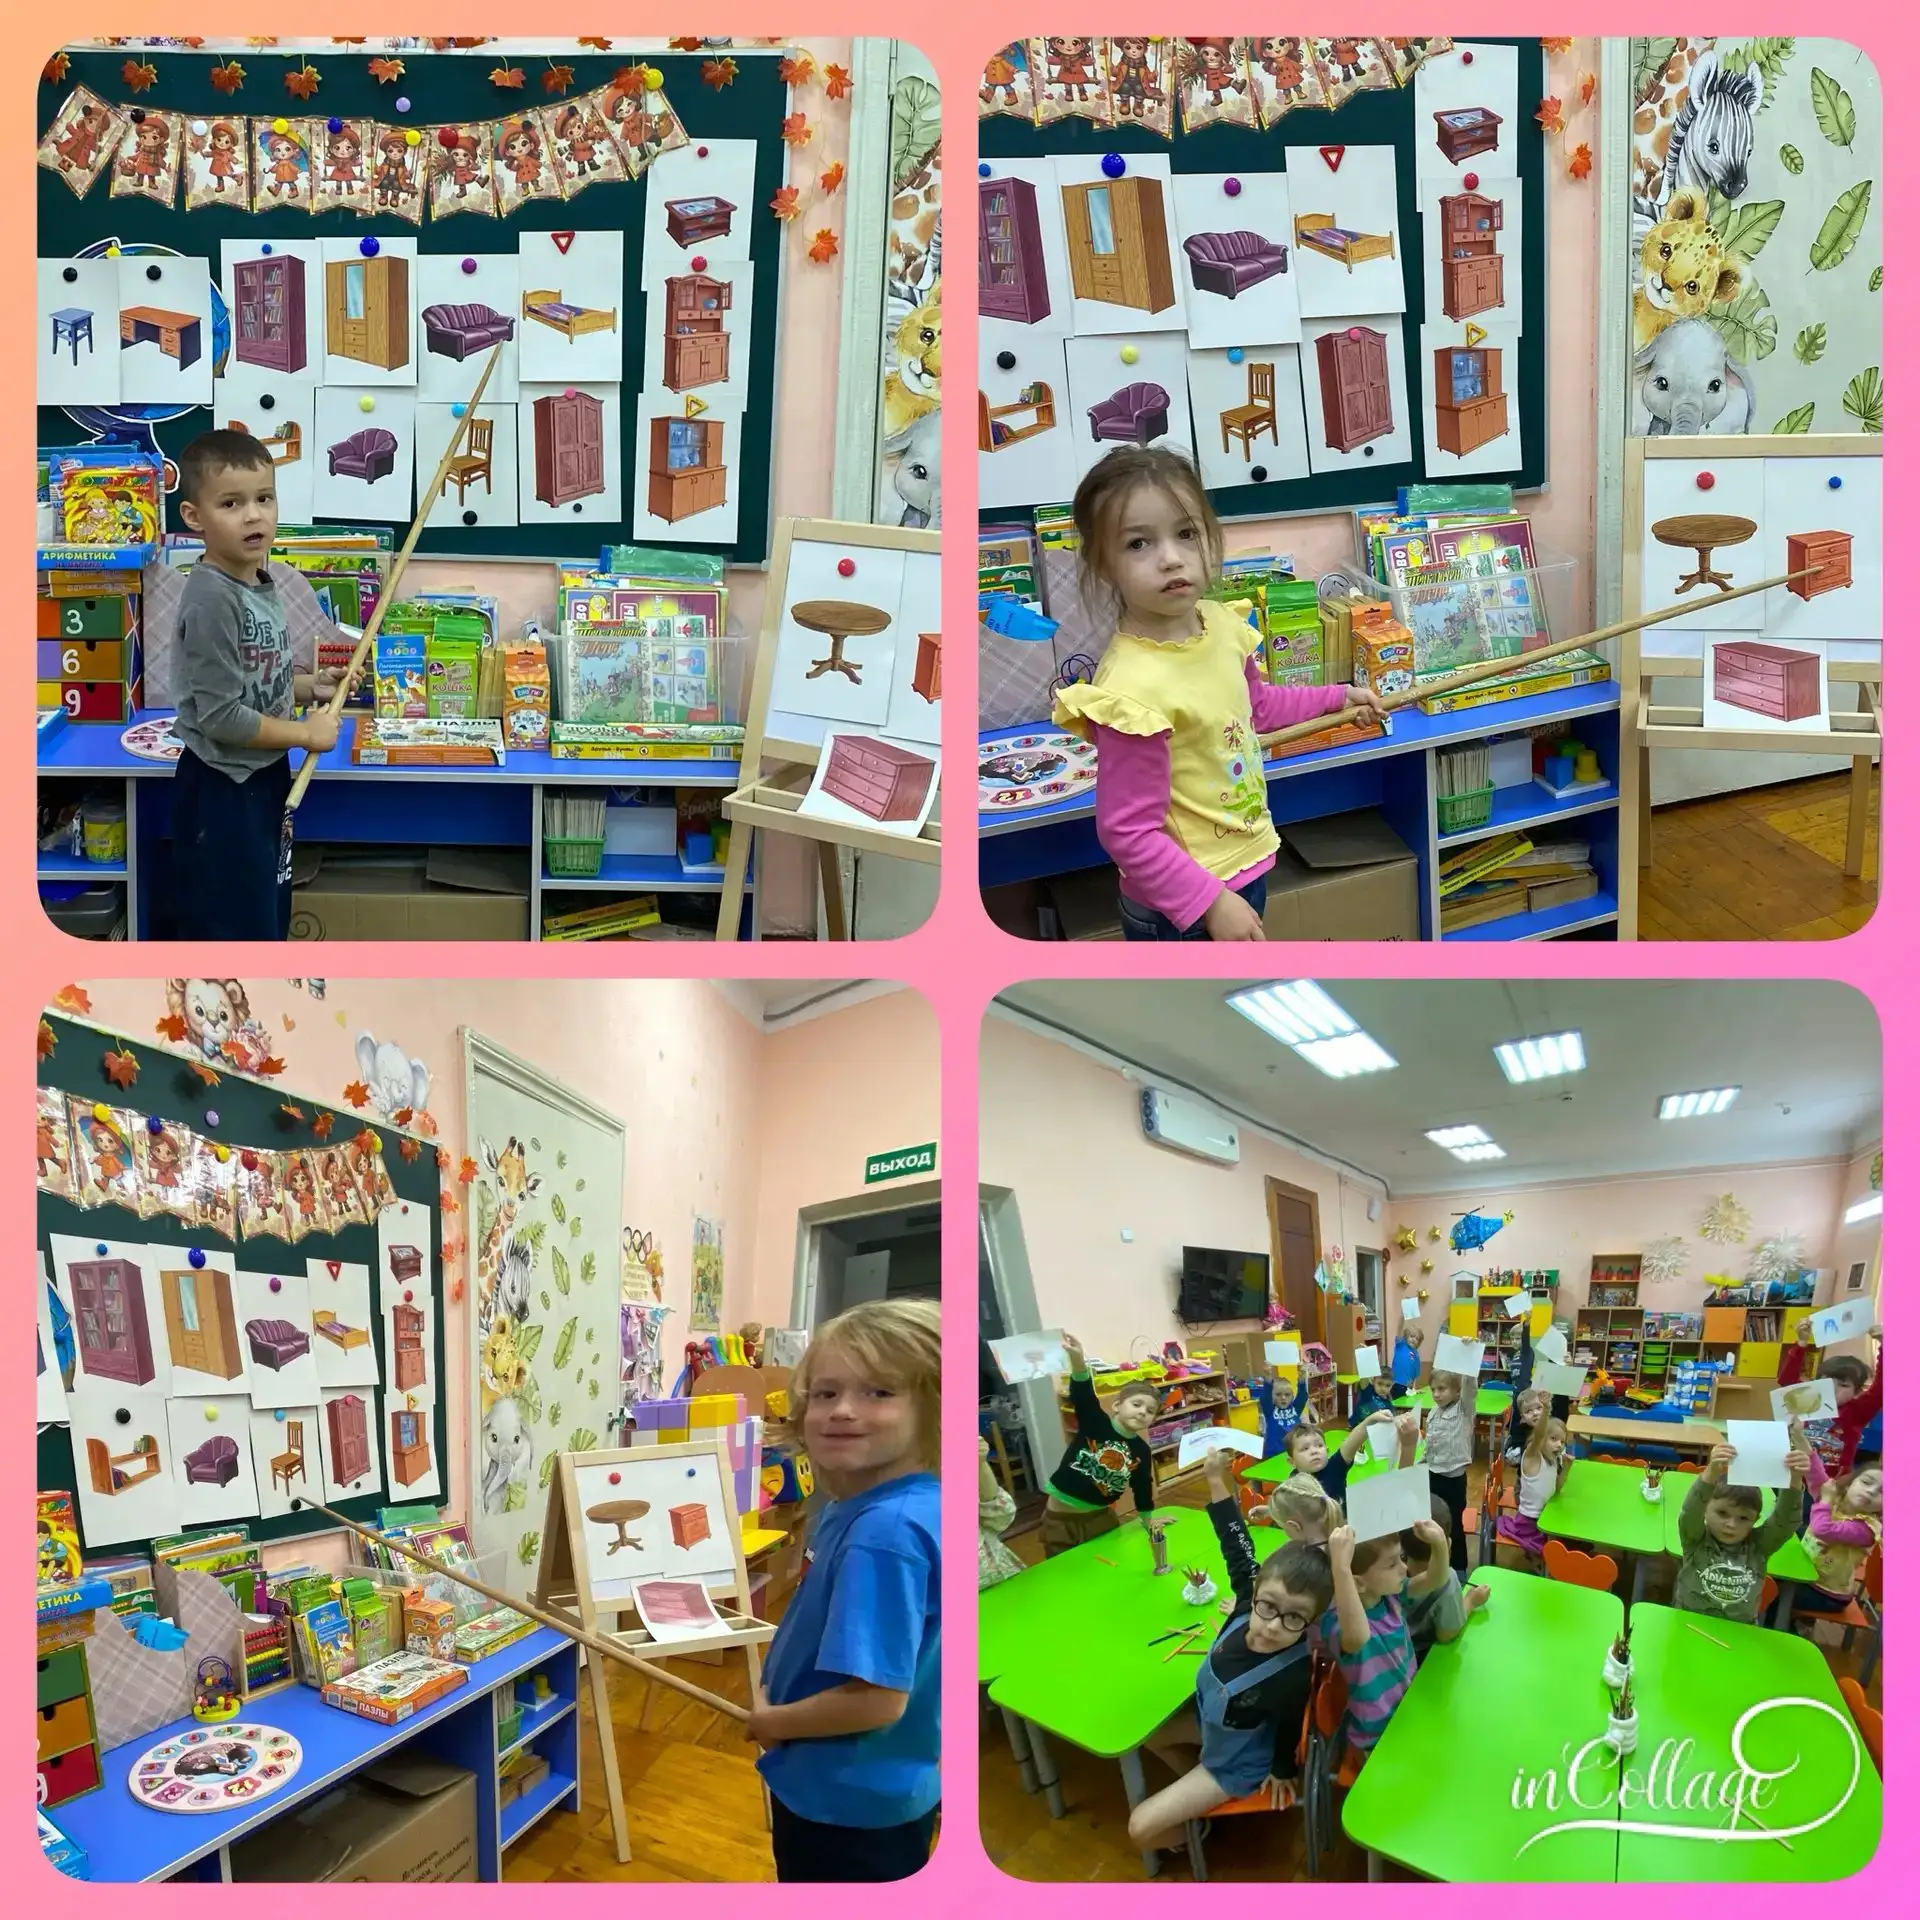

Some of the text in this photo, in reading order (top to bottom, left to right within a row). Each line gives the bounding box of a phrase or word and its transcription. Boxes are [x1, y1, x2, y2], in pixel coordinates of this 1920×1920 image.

[42, 552, 117, 560] АРИФМЕТИКА
[65, 609, 84, 634] 3
[62, 649, 81, 674] 6
[432, 683, 473, 692] КОШКА
[65, 689, 81, 717] 9
[869, 1152, 931, 1176] ВЫХОД
[375, 1651, 410, 1671] ПАЗЛЫ
[358, 1702, 389, 1719] ПАЗЛЫ
